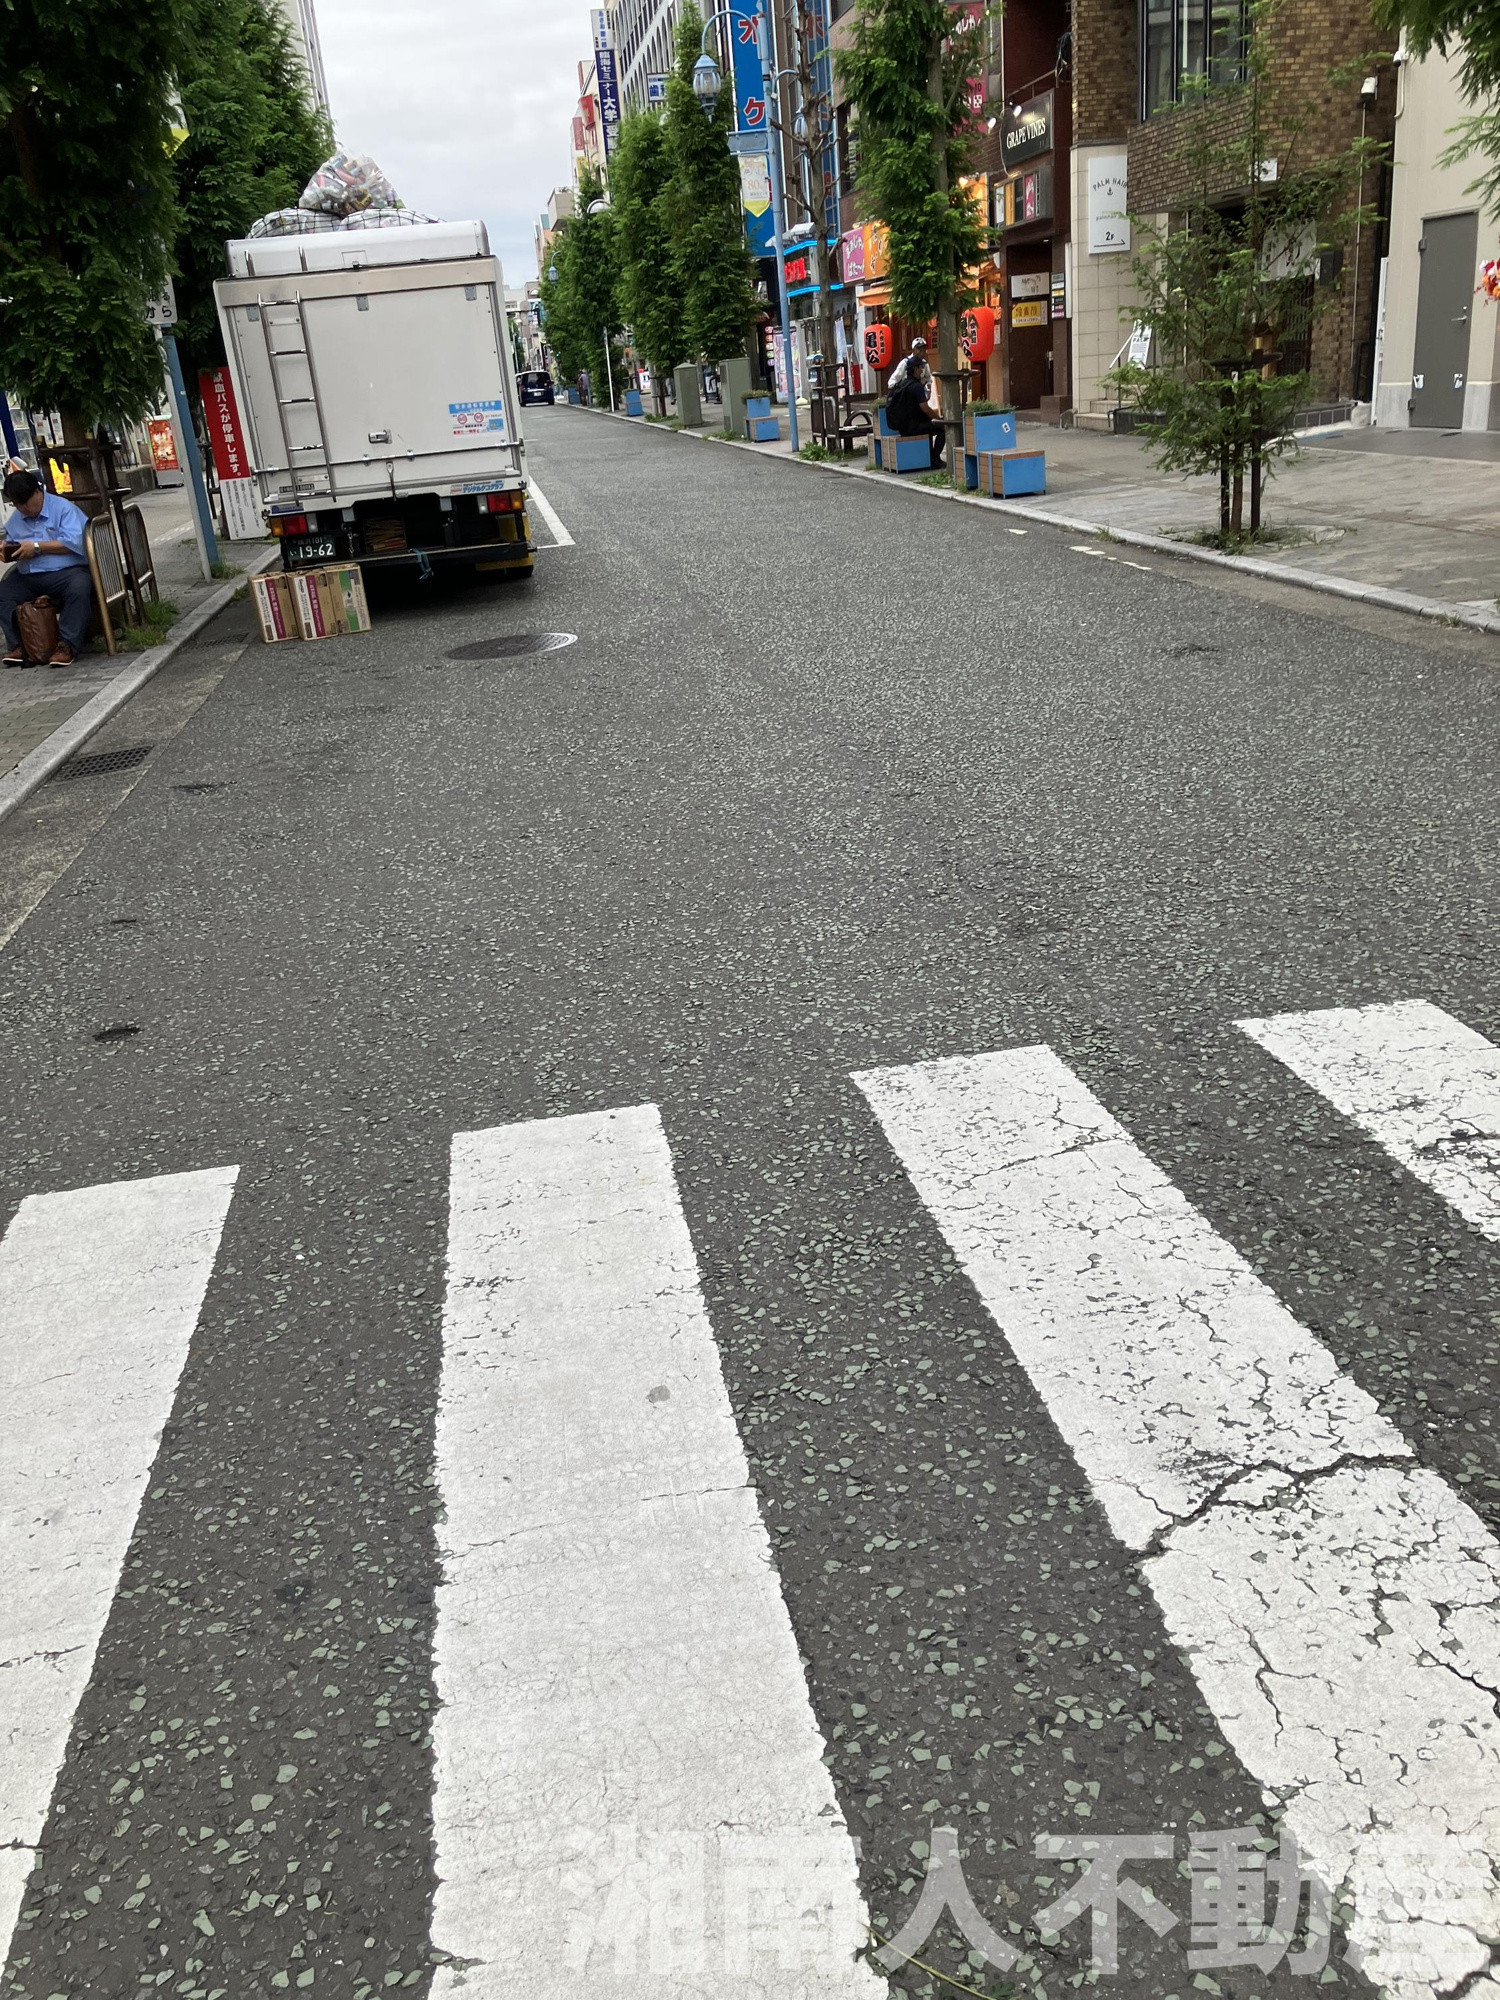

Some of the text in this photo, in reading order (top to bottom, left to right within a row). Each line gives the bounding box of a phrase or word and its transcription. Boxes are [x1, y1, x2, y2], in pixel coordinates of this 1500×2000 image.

[1006, 117, 1046, 149] GRAPE VINES
[1092, 177, 1128, 191] PALM HAIR
[1105, 231, 1115, 241] 2F
[299, 543, 334, 559] 19-62
